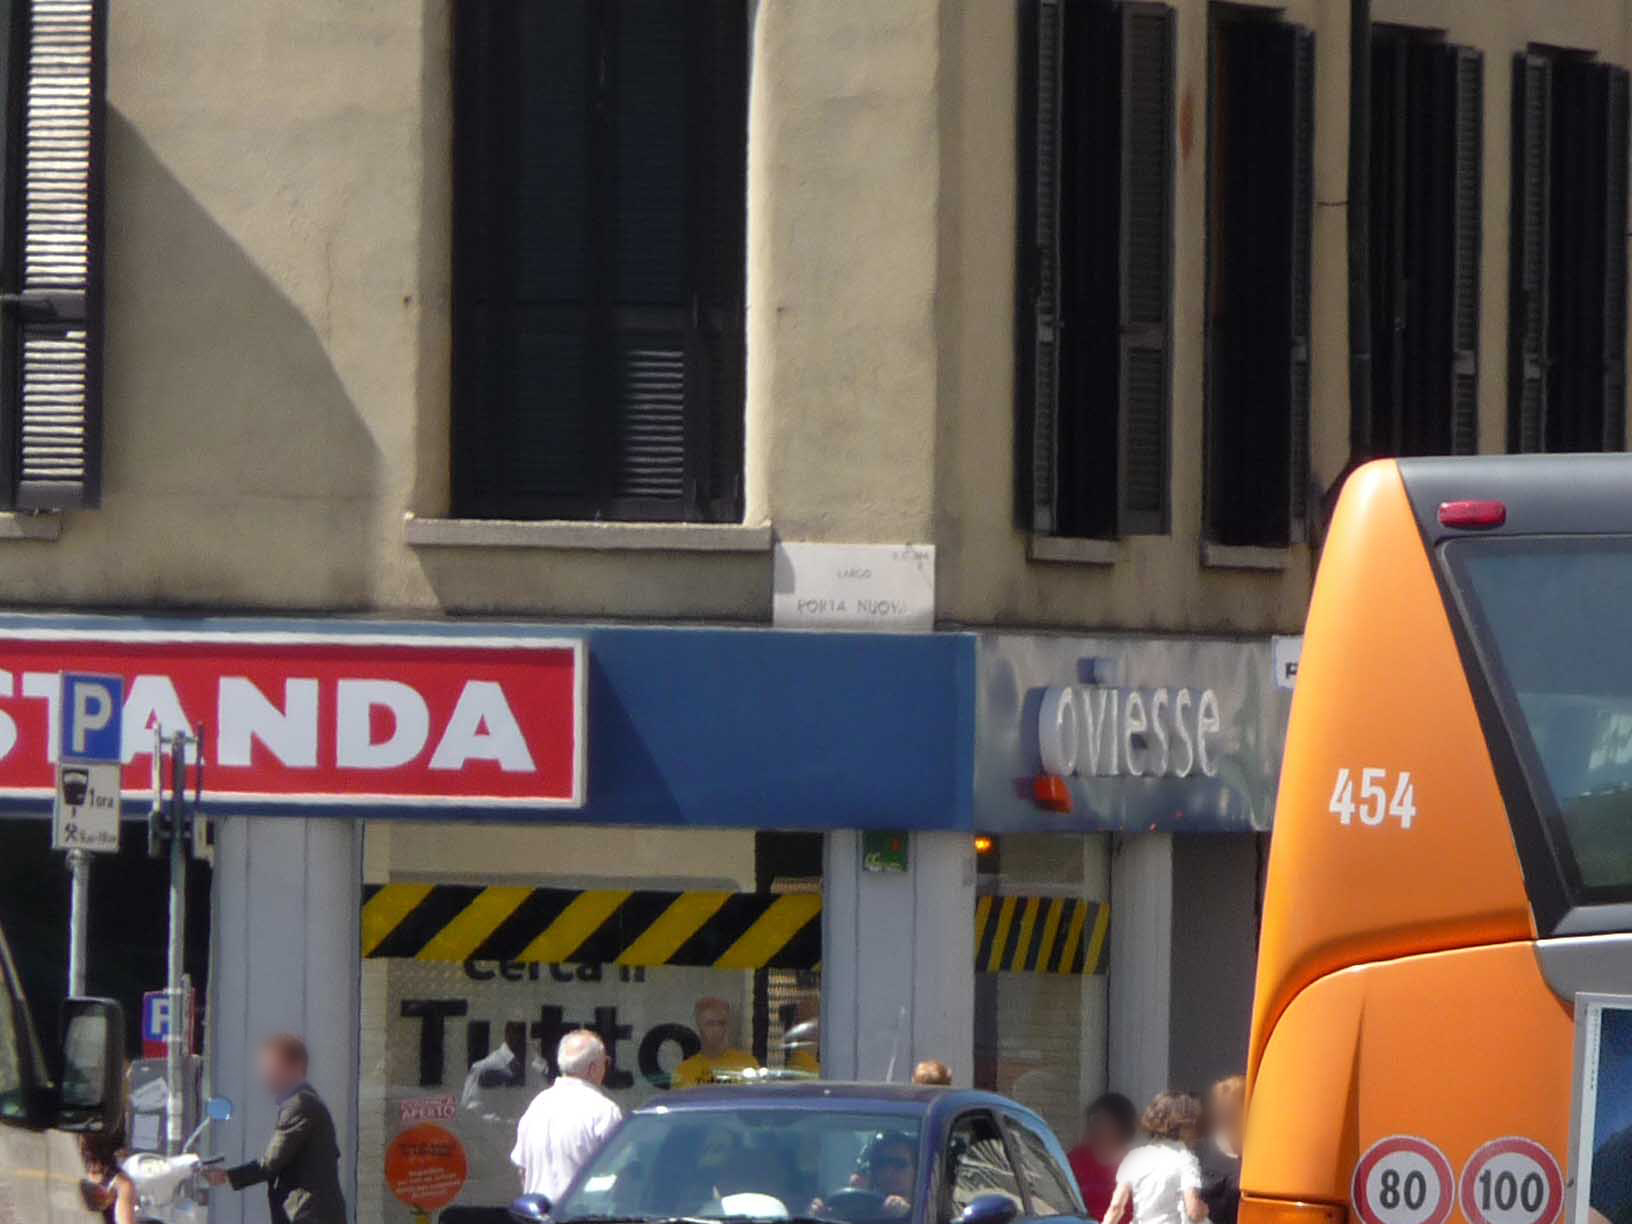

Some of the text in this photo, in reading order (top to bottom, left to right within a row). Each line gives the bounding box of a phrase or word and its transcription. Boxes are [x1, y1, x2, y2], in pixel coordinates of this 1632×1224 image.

[798, 600, 847, 615] PORTA
[72, 682, 112, 752] P
[1056, 686, 1220, 778] oviesse
[1329, 767, 1416, 829] 454
[1379, 1168, 1427, 1211] 80
[1479, 1168, 1545, 1213] 100
